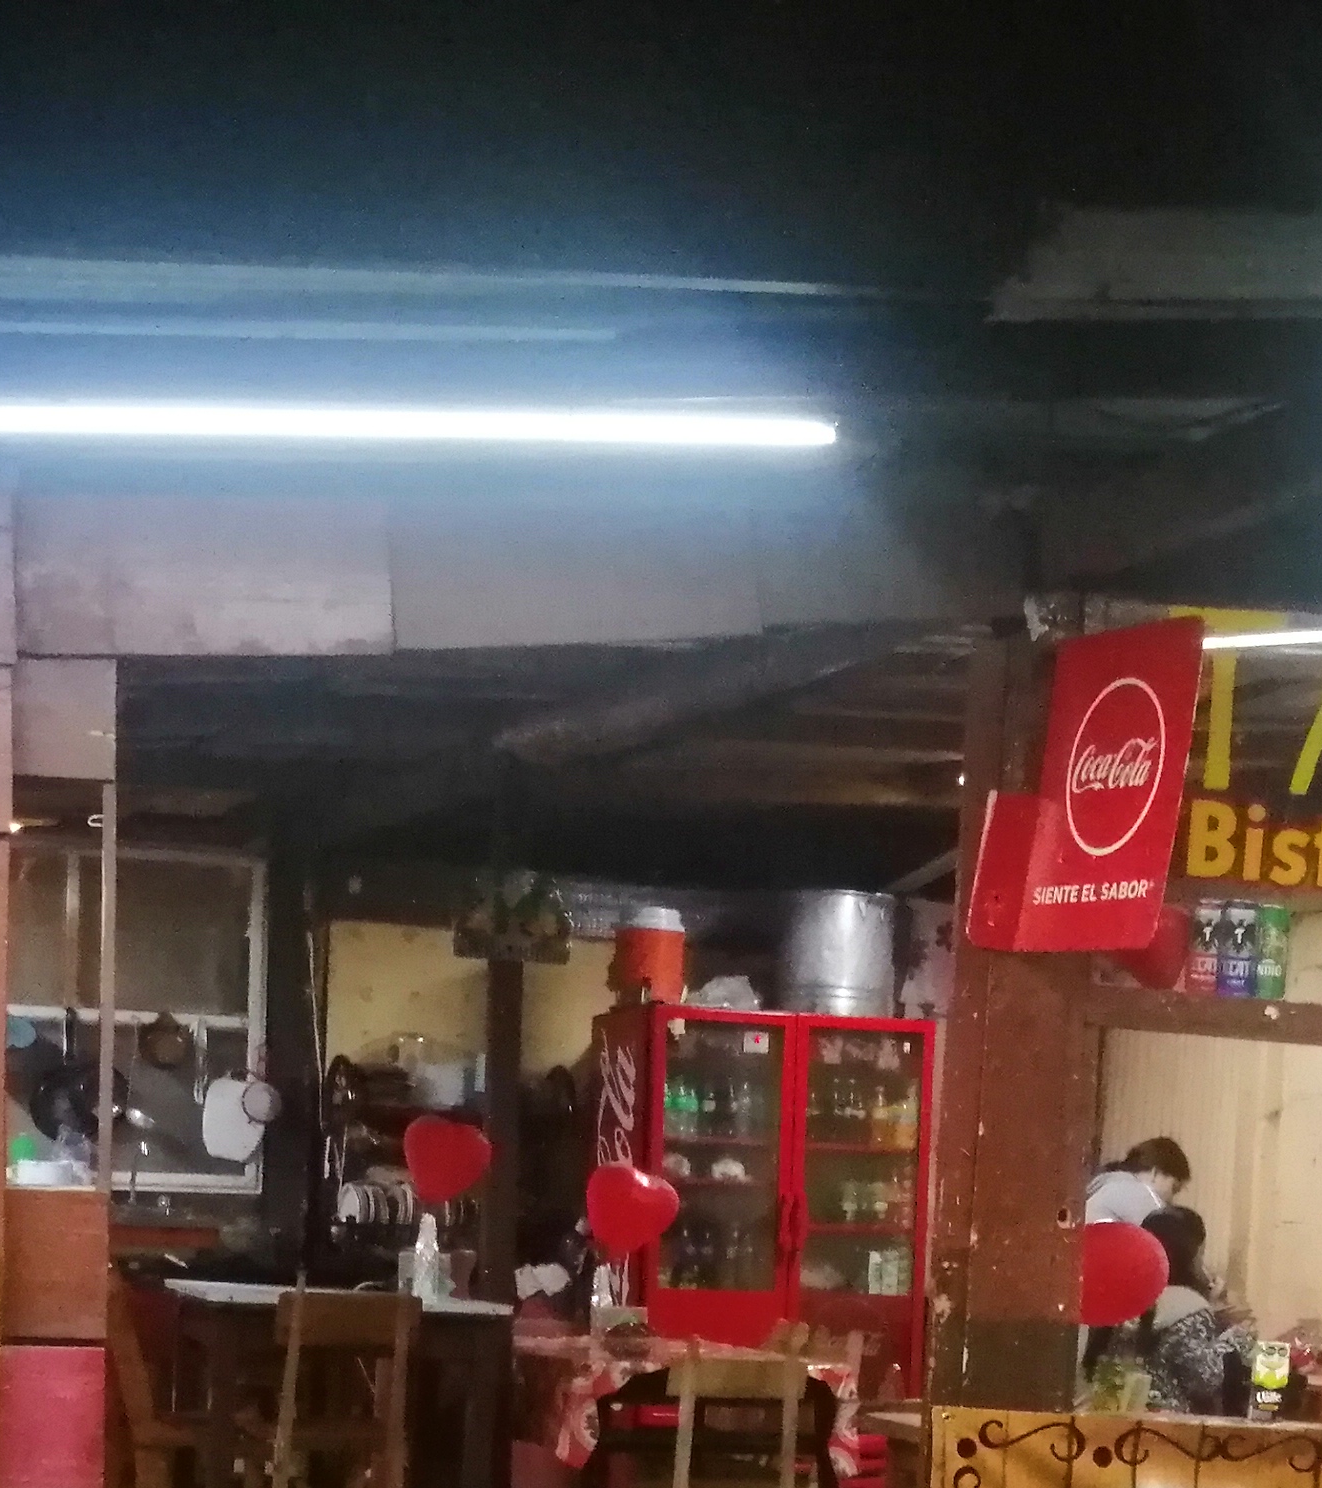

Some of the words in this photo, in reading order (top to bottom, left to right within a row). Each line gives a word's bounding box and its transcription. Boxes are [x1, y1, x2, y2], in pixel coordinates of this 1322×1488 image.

[1032, 885, 1079, 905] SIENTE
[1081, 884, 1097, 900] EL
[1100, 879, 1148, 900] SABOR
